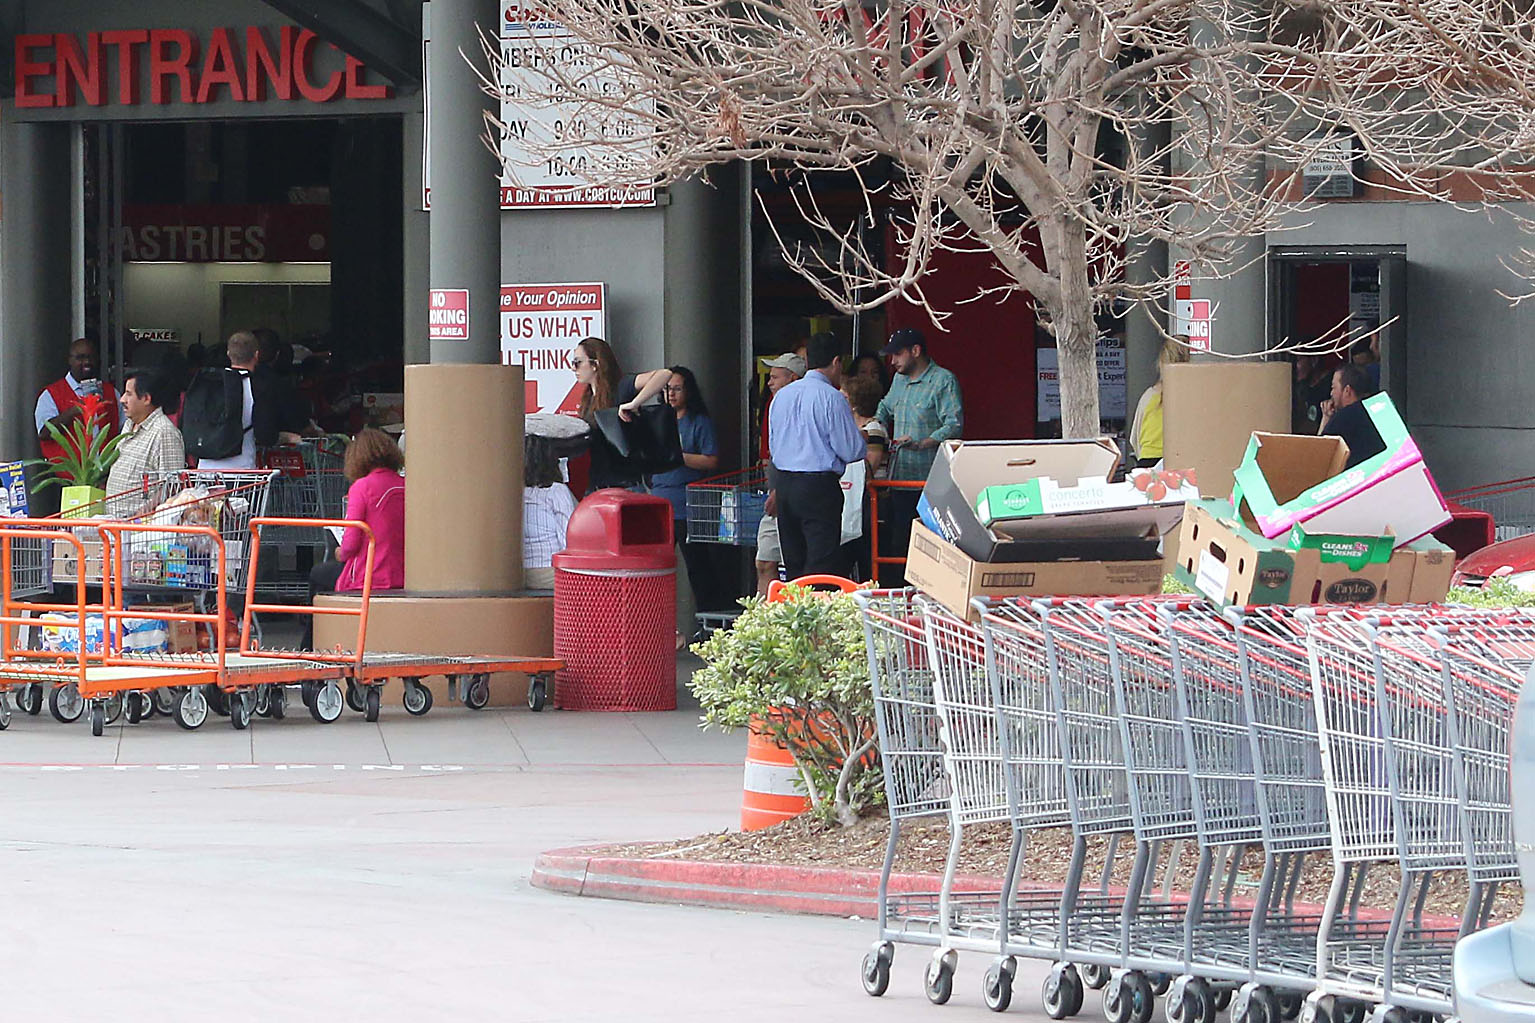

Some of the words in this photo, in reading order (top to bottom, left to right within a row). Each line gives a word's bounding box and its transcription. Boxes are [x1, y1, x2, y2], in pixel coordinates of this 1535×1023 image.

[14, 26, 392, 109] ENTRANCE
[432, 292, 446, 308] NO
[515, 291, 544, 306] Your
[547, 289, 597, 308] Opinion
[442, 327, 464, 336] AREA
[509, 317, 533, 339] US
[538, 316, 593, 338] WHAT
[1039, 372, 1057, 381] FREE
[1048, 487, 1104, 501] concerto
[1322, 542, 1353, 550] CLEANS
[1334, 584, 1371, 594] Taylor
